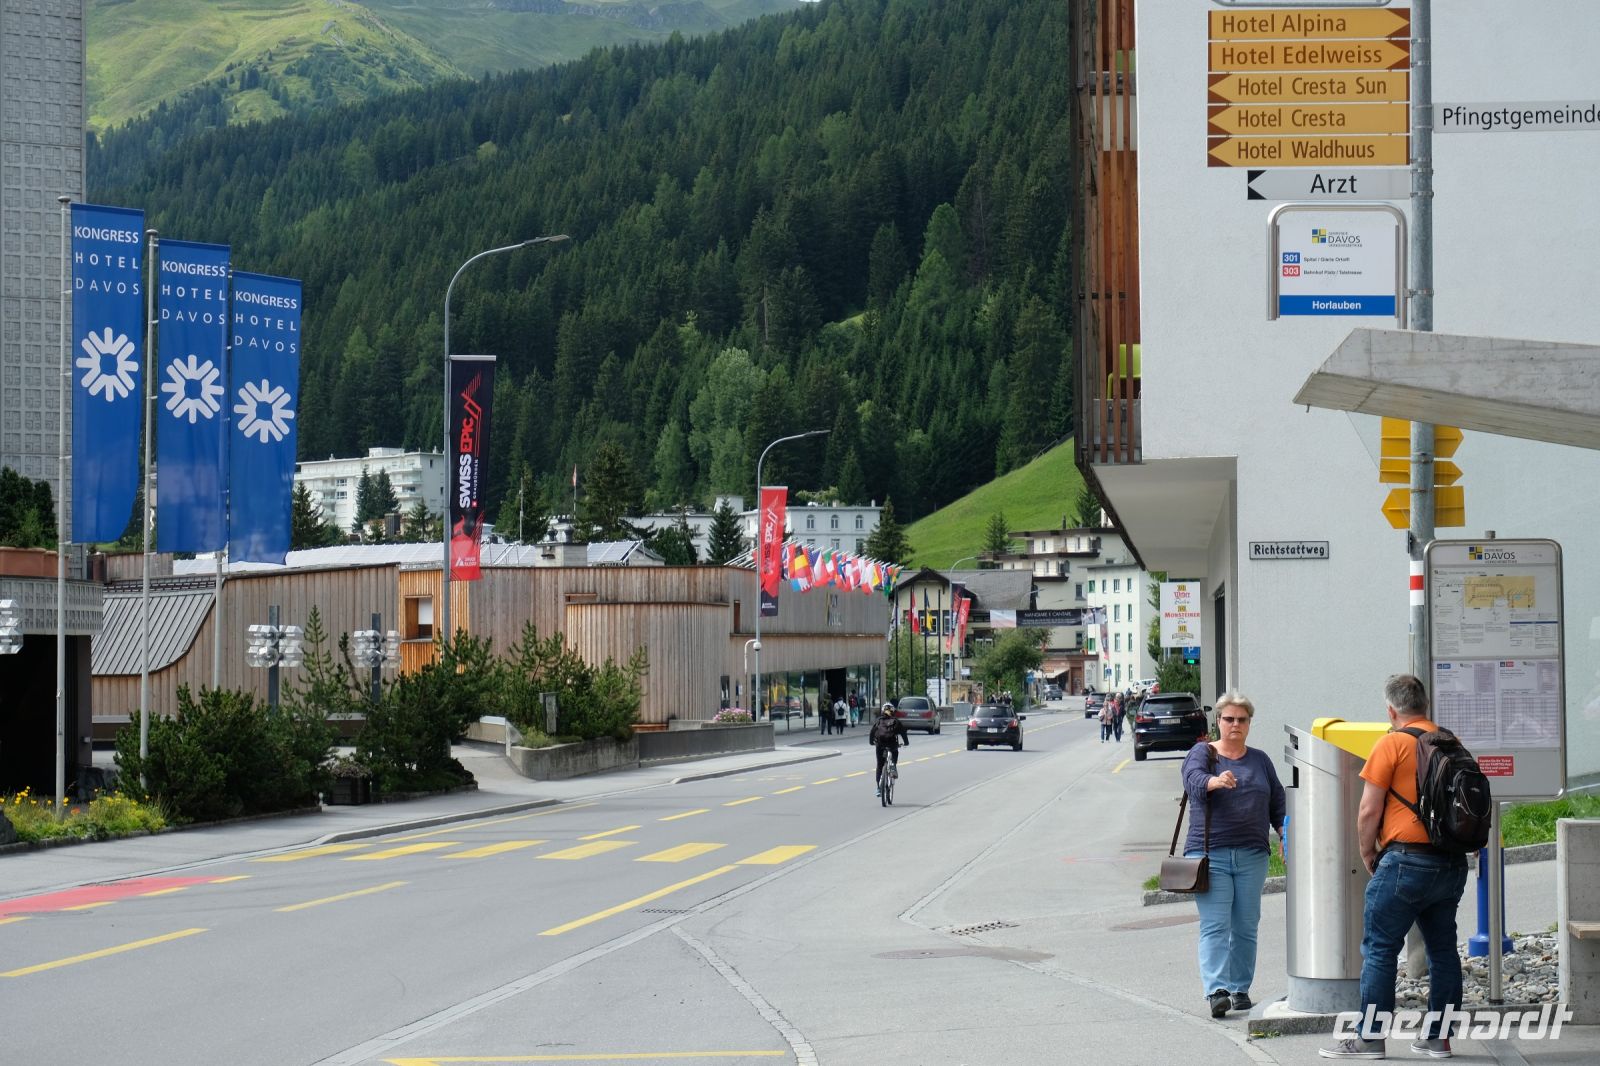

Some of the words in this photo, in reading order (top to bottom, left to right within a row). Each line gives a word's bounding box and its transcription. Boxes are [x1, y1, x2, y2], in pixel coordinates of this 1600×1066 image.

[1222, 15, 1275, 33] Hotel
[1282, 14, 1346, 36] Alpina
[1222, 46, 1274, 65] Hotel
[1284, 45, 1382, 64] Edelweiss
[1238, 77, 1282, 95] Hotel
[1292, 77, 1346, 95] Cresta
[1356, 77, 1387, 94] Sun
[1238, 108, 1282, 127] Hotel
[1291, 109, 1346, 127] Cresta
[1443, 104, 1600, 130] Pfingstgemeind
[1238, 140, 1282, 159] Hotel
[1291, 139, 1375, 158] Waldhuus
[1310, 174, 1357, 193] Arzt
[74, 226, 139, 244] KONGRESS
[1328, 235, 1361, 244] DAVOS
[75, 252, 139, 270] HOTEL
[1284, 254, 1298, 262] 301
[162, 260, 226, 277] KONGRESS
[1283, 267, 1299, 275] 303
[75, 277, 139, 295] DAVOS
[162, 284, 226, 301] HOTEL
[235, 290, 298, 309] KONGRESS
[1312, 301, 1361, 310] Horlauben
[162, 308, 226, 325] DAVOS
[235, 313, 297, 331] HOTEL
[234, 335, 296, 353] DAVOS
[460, 417, 474, 453] EPIC
[459, 453, 472, 509] SWISS
[764, 521, 774, 543] EPIC
[1254, 544, 1325, 556] Richtstattweg
[1484, 551, 1516, 560] DAVOS
